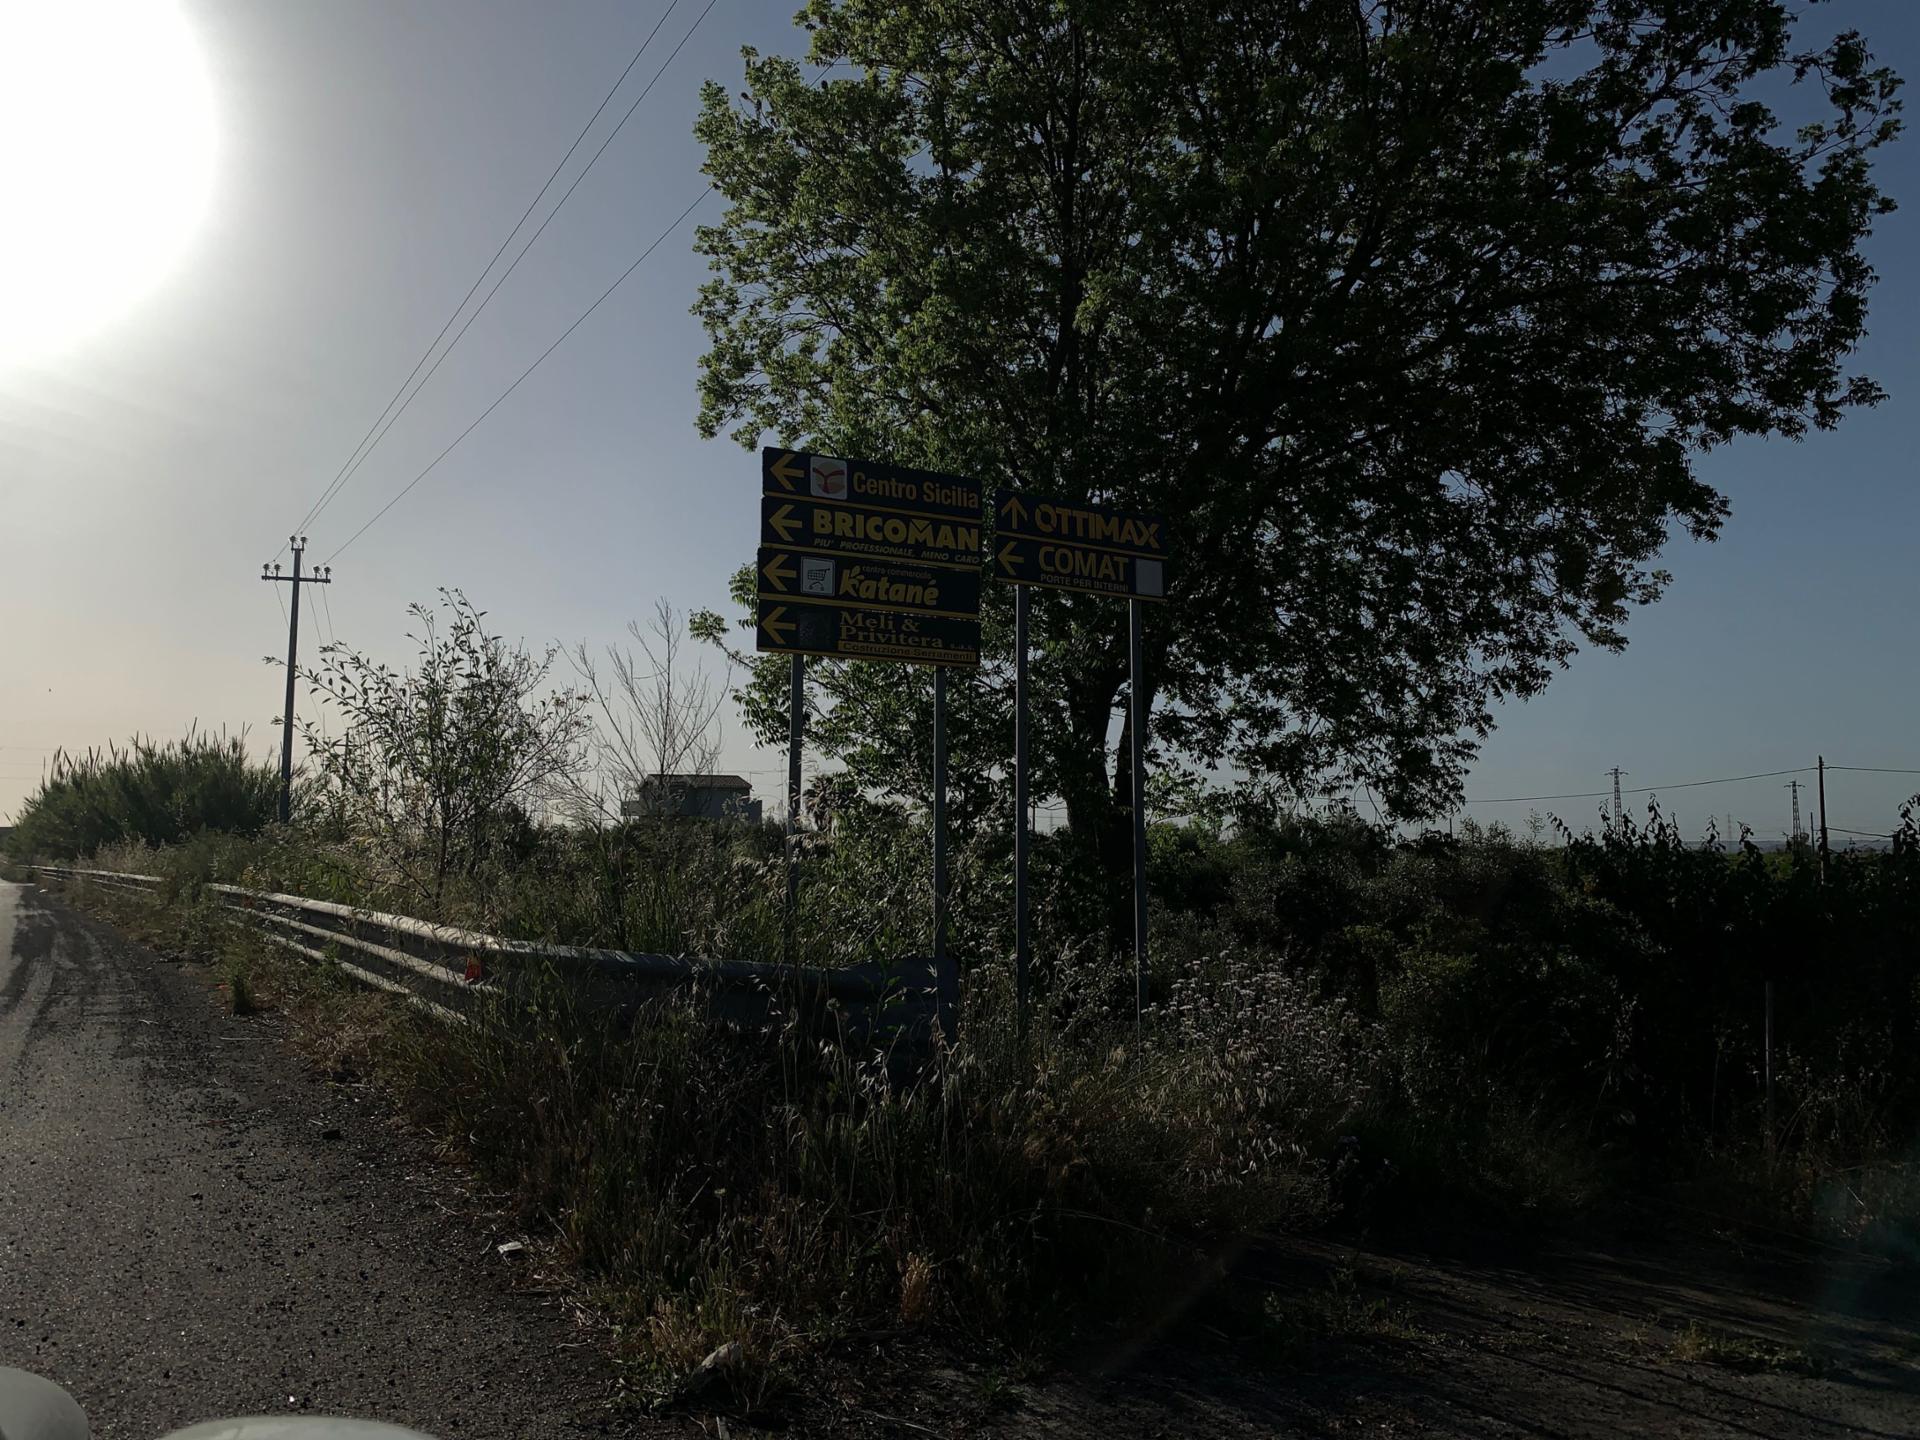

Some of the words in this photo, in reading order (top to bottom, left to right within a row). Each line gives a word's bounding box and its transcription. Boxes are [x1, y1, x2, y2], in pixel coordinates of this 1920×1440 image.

[852, 471, 917, 500] Centro
[922, 480, 979, 509] Sicilia
[812, 508, 979, 550] BRICOMAN
[1034, 503, 1161, 549] OTTIMAX
[1039, 546, 1129, 582] COMAT
[1040, 573, 1071, 586] PORTE
[1073, 578, 1091, 588] PER
[1093, 581, 1129, 593] INTERNI
[840, 611, 896, 630] Meli
[901, 618, 921, 632] &
[840, 625, 944, 648] Privitera
